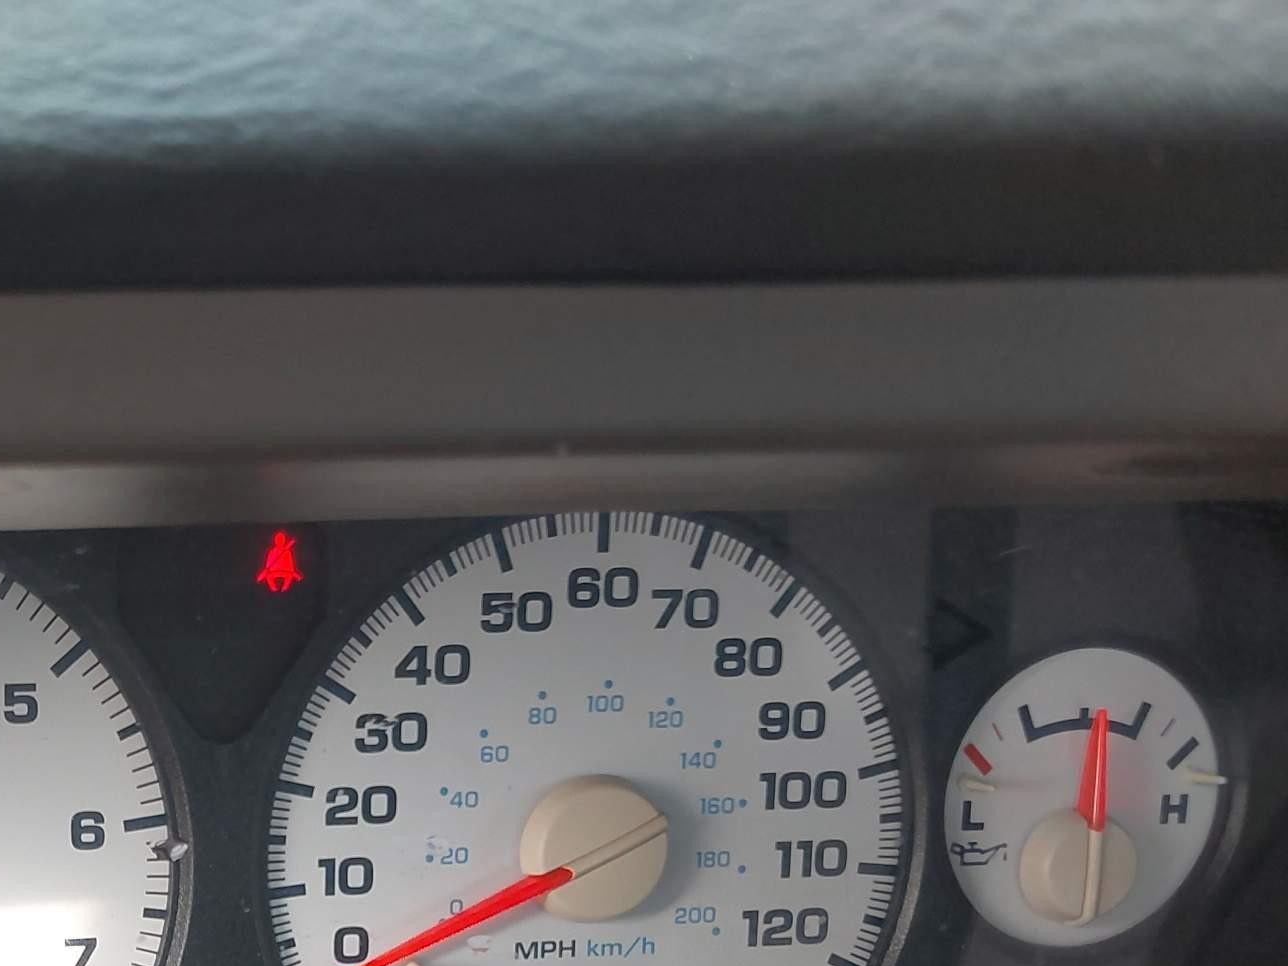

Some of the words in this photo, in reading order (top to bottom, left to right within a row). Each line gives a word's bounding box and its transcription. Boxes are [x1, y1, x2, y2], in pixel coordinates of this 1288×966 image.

[567, 567, 638, 608] 60
[480, 592, 552, 633] 50
[652, 588, 718, 629] 70
[394, 644, 470, 686] 40
[714, 637, 782, 676] 80
[4, 683, 38, 724] 5
[528, 707, 557, 724] 80
[587, 695, 624, 712] 100
[648, 711, 684, 728] 120
[759, 700, 826, 740] 90
[355, 712, 428, 753] 30
[480, 745, 509, 763] 60
[680, 752, 716, 770] 140
[324, 785, 398, 826] 20
[449, 791, 479, 808] 40
[700, 797, 735, 815] 160
[759, 771, 847, 811] 100
[1159, 794, 1188, 824] H
[71, 812, 105, 850] 6
[962, 801, 984, 831] L
[440, 847, 469, 865] 20
[696, 851, 730, 868] 180
[775, 839, 848, 879] 110
[318, 857, 374, 896] 10
[450, 900, 464, 915] 0
[674, 907, 716, 924] 200
[333, 926, 369, 964] 0
[742, 908, 828, 946] 120
[515, 940, 576, 959] MPH
[587, 937, 655, 957] km/h
